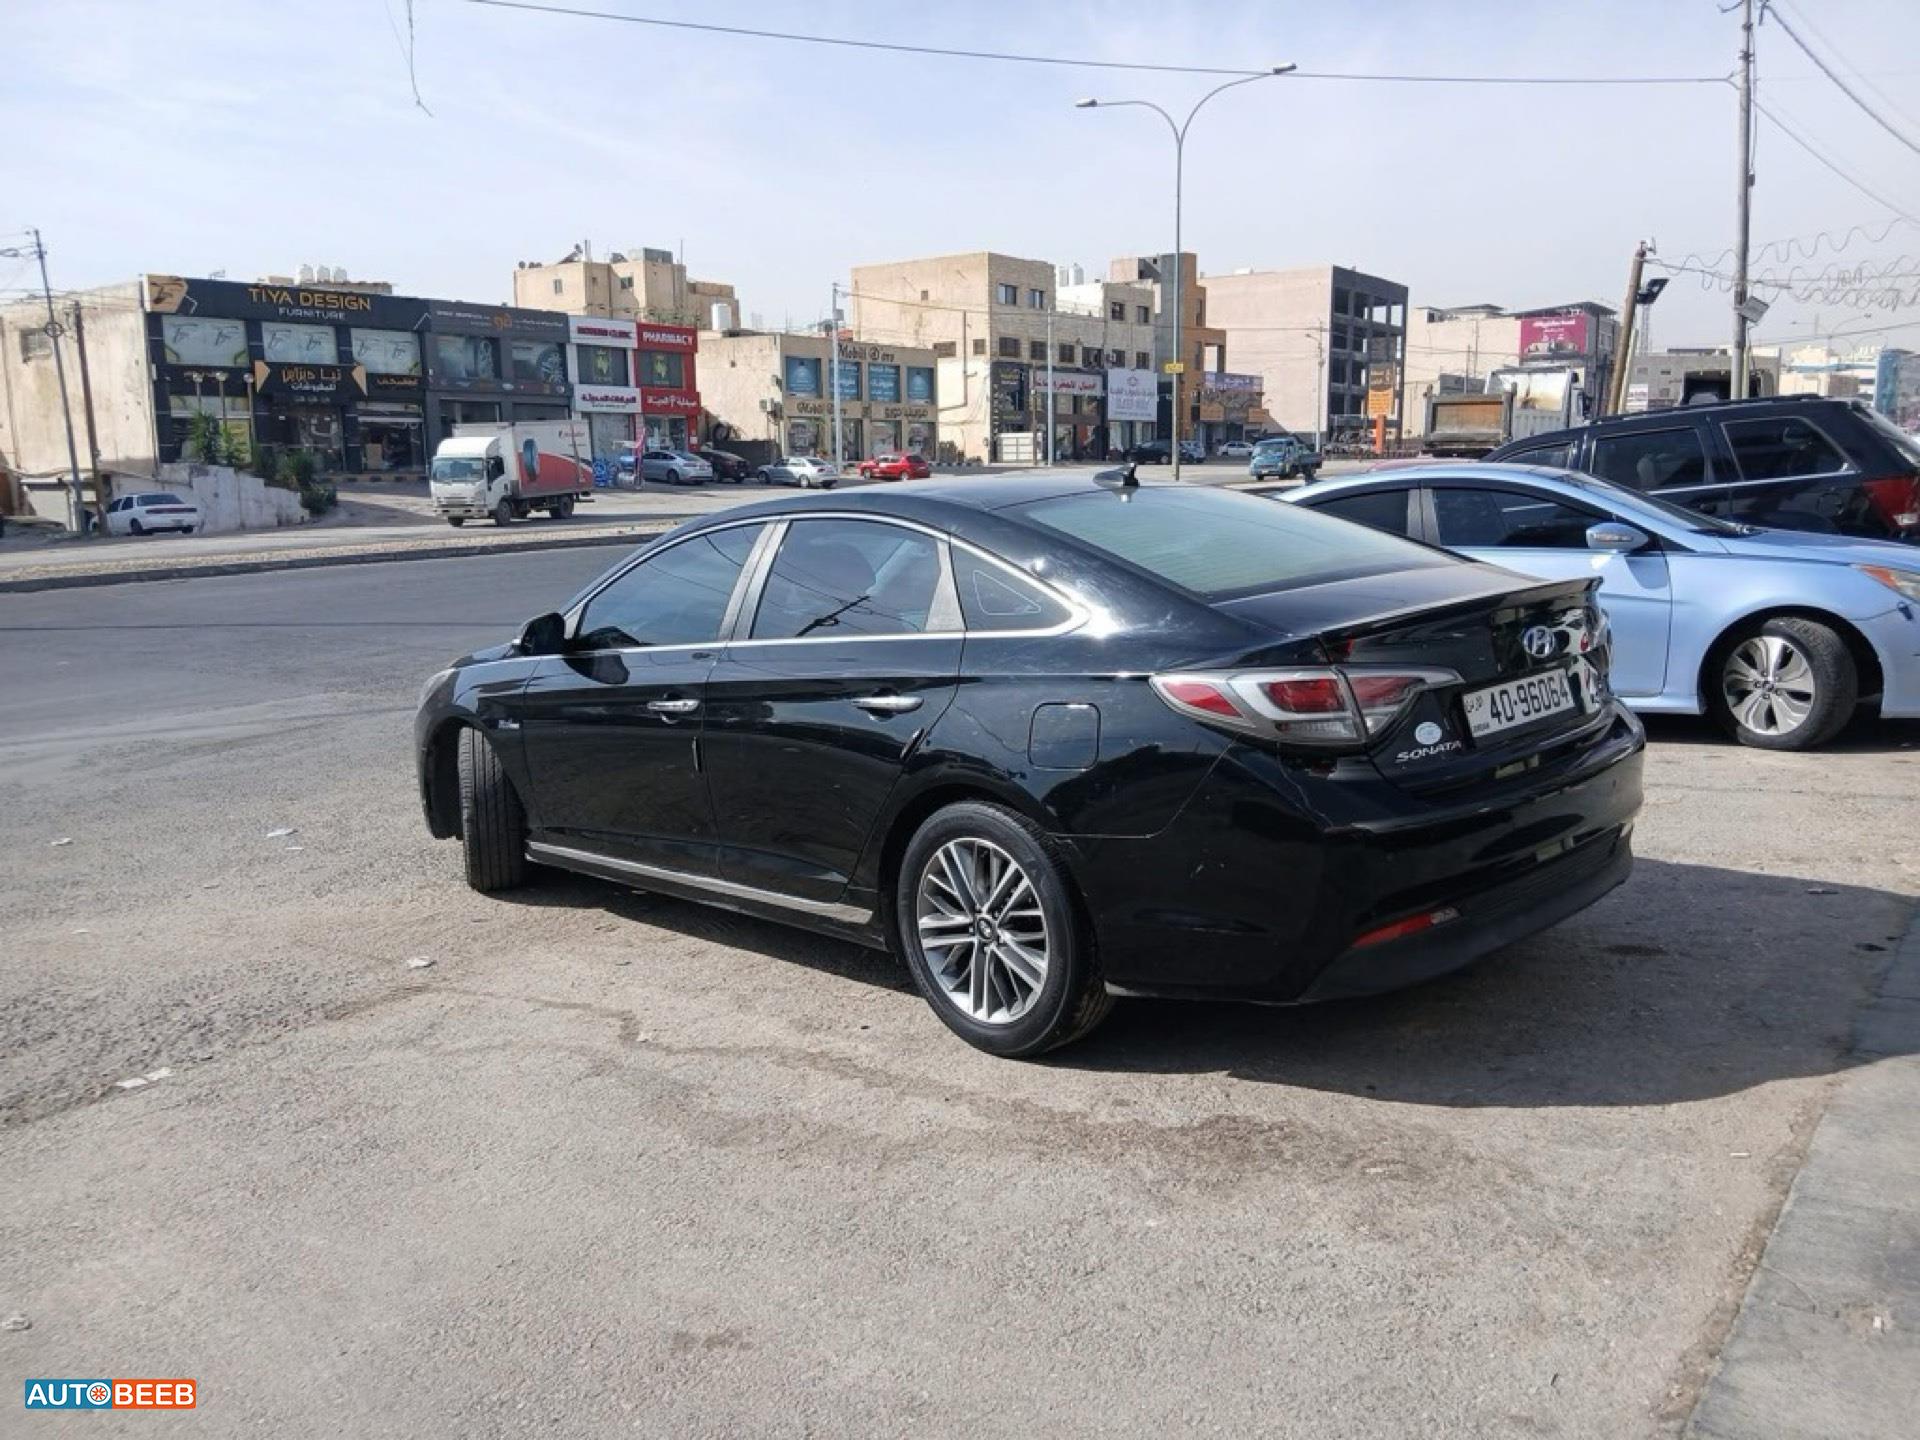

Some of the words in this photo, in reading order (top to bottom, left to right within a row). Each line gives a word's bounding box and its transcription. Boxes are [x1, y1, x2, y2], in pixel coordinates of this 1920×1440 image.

[248, 288, 293, 305] TIYA
[299, 292, 371, 311] DESIGN
[279, 307, 346, 320] FURNITURE
[642, 331, 693, 346] PHARMACY
[1490, 672, 1570, 725] 40-96064
[1395, 740, 1462, 764] SONATA
